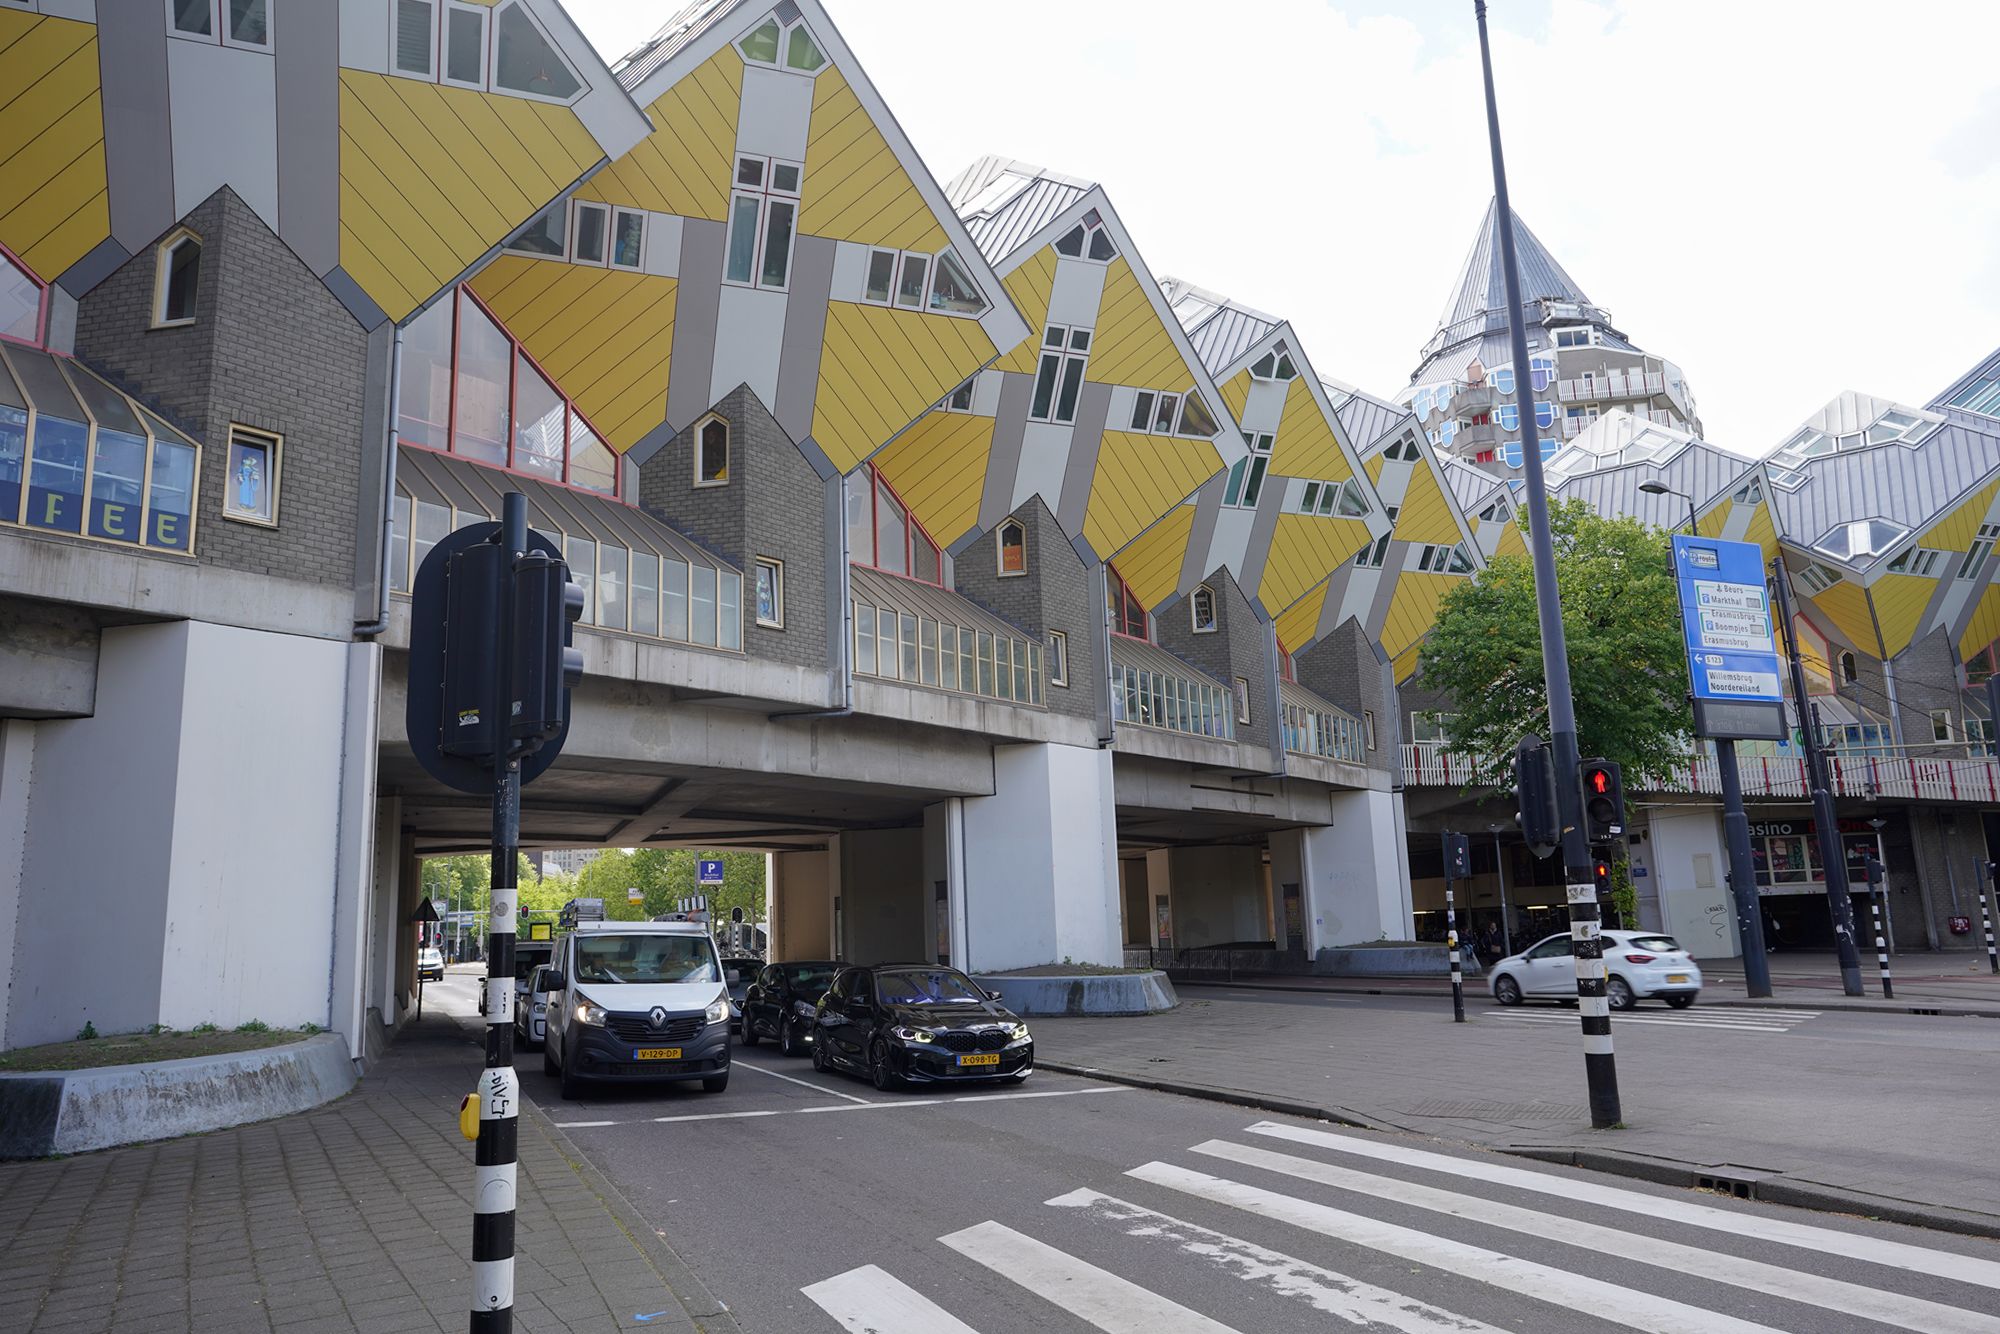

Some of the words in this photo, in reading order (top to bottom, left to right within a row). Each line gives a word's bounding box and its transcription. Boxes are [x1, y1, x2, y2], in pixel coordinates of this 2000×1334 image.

[1724, 584, 1744, 594] Beurs
[1711, 595, 1742, 606] Markthal
[1711, 609, 1756, 622] Erasmusbrug
[1715, 622, 1749, 634] Boompjes
[1704, 635, 1749, 648] Erasmusbrug
[1709, 671, 1753, 683] Willemsbrug
[1710, 682, 1760, 693] Noordereiland
[1747, 821, 1792, 836] asino
[707, 862, 716, 873] P
[641, 1050, 678, 1058] V-129-DP
[962, 1055, 997, 1064] X-098-TG
